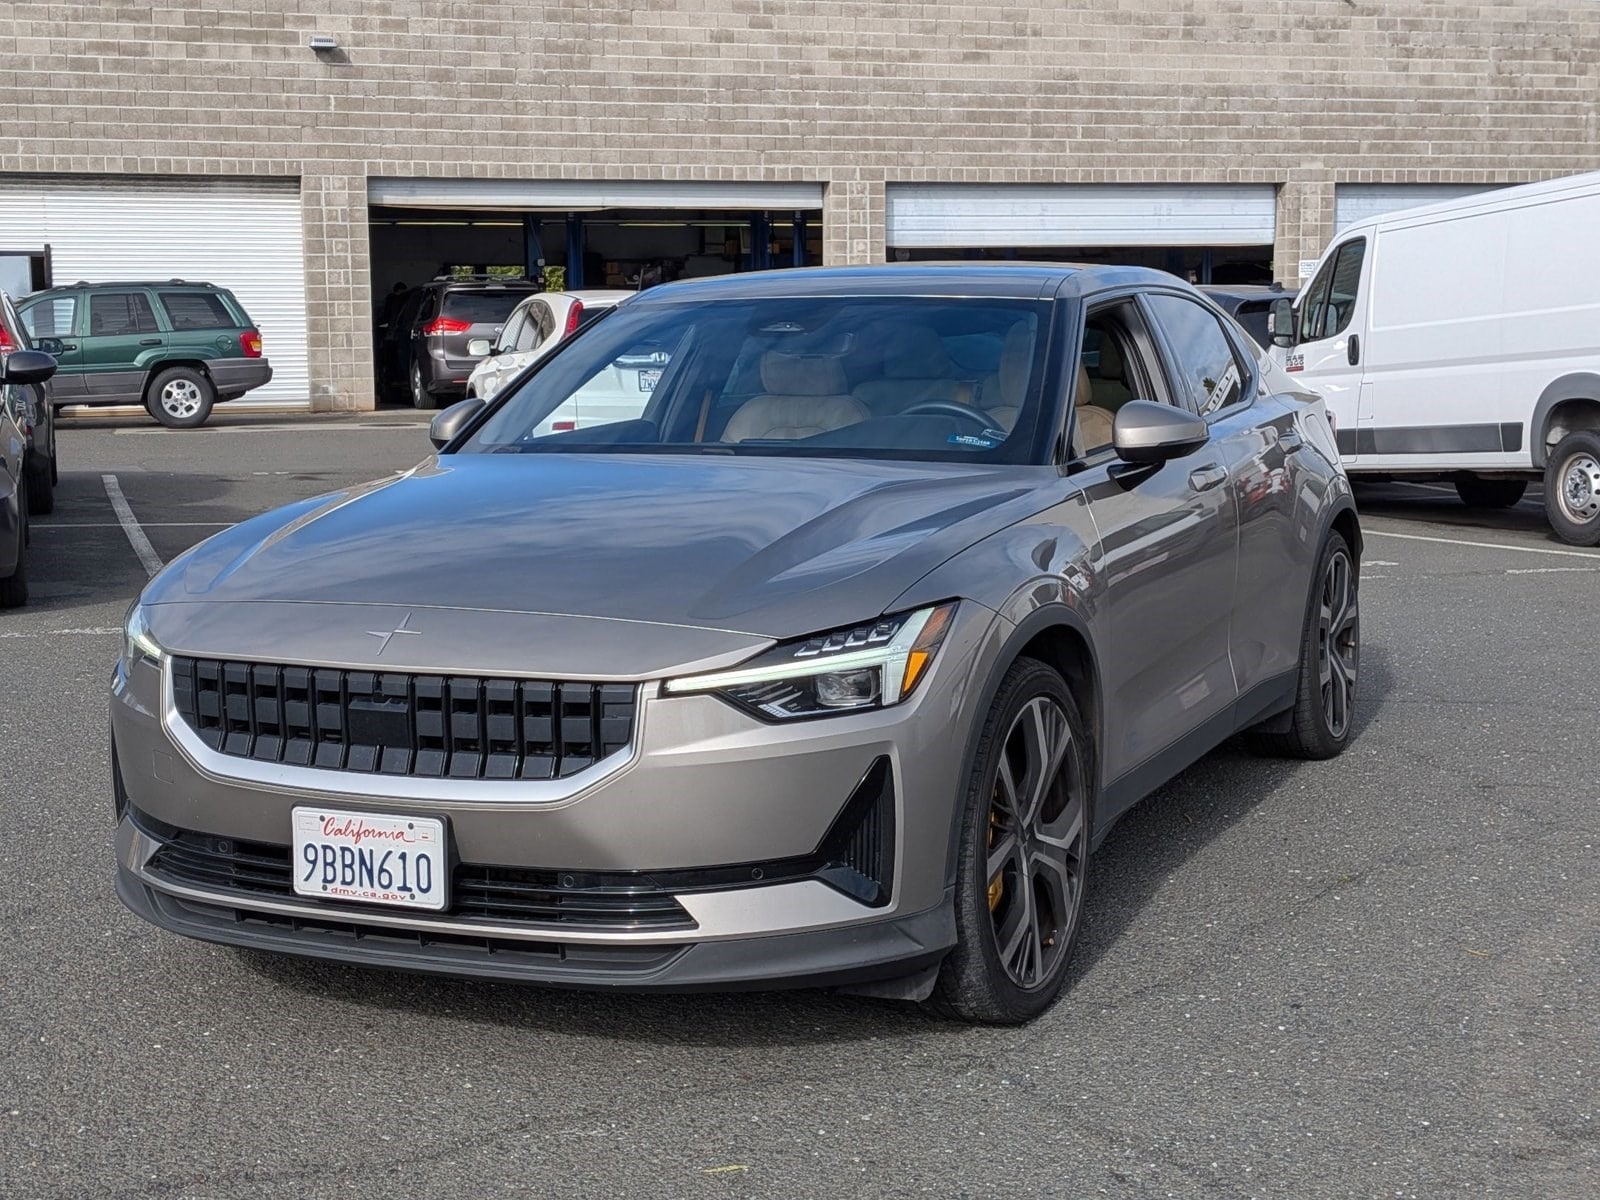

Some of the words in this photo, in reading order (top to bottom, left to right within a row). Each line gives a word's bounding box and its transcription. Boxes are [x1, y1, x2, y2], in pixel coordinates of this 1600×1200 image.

[323, 816, 416, 844] California
[303, 843, 432, 894] 9BBN610
[330, 887, 406, 900] dmv.ca.gov
